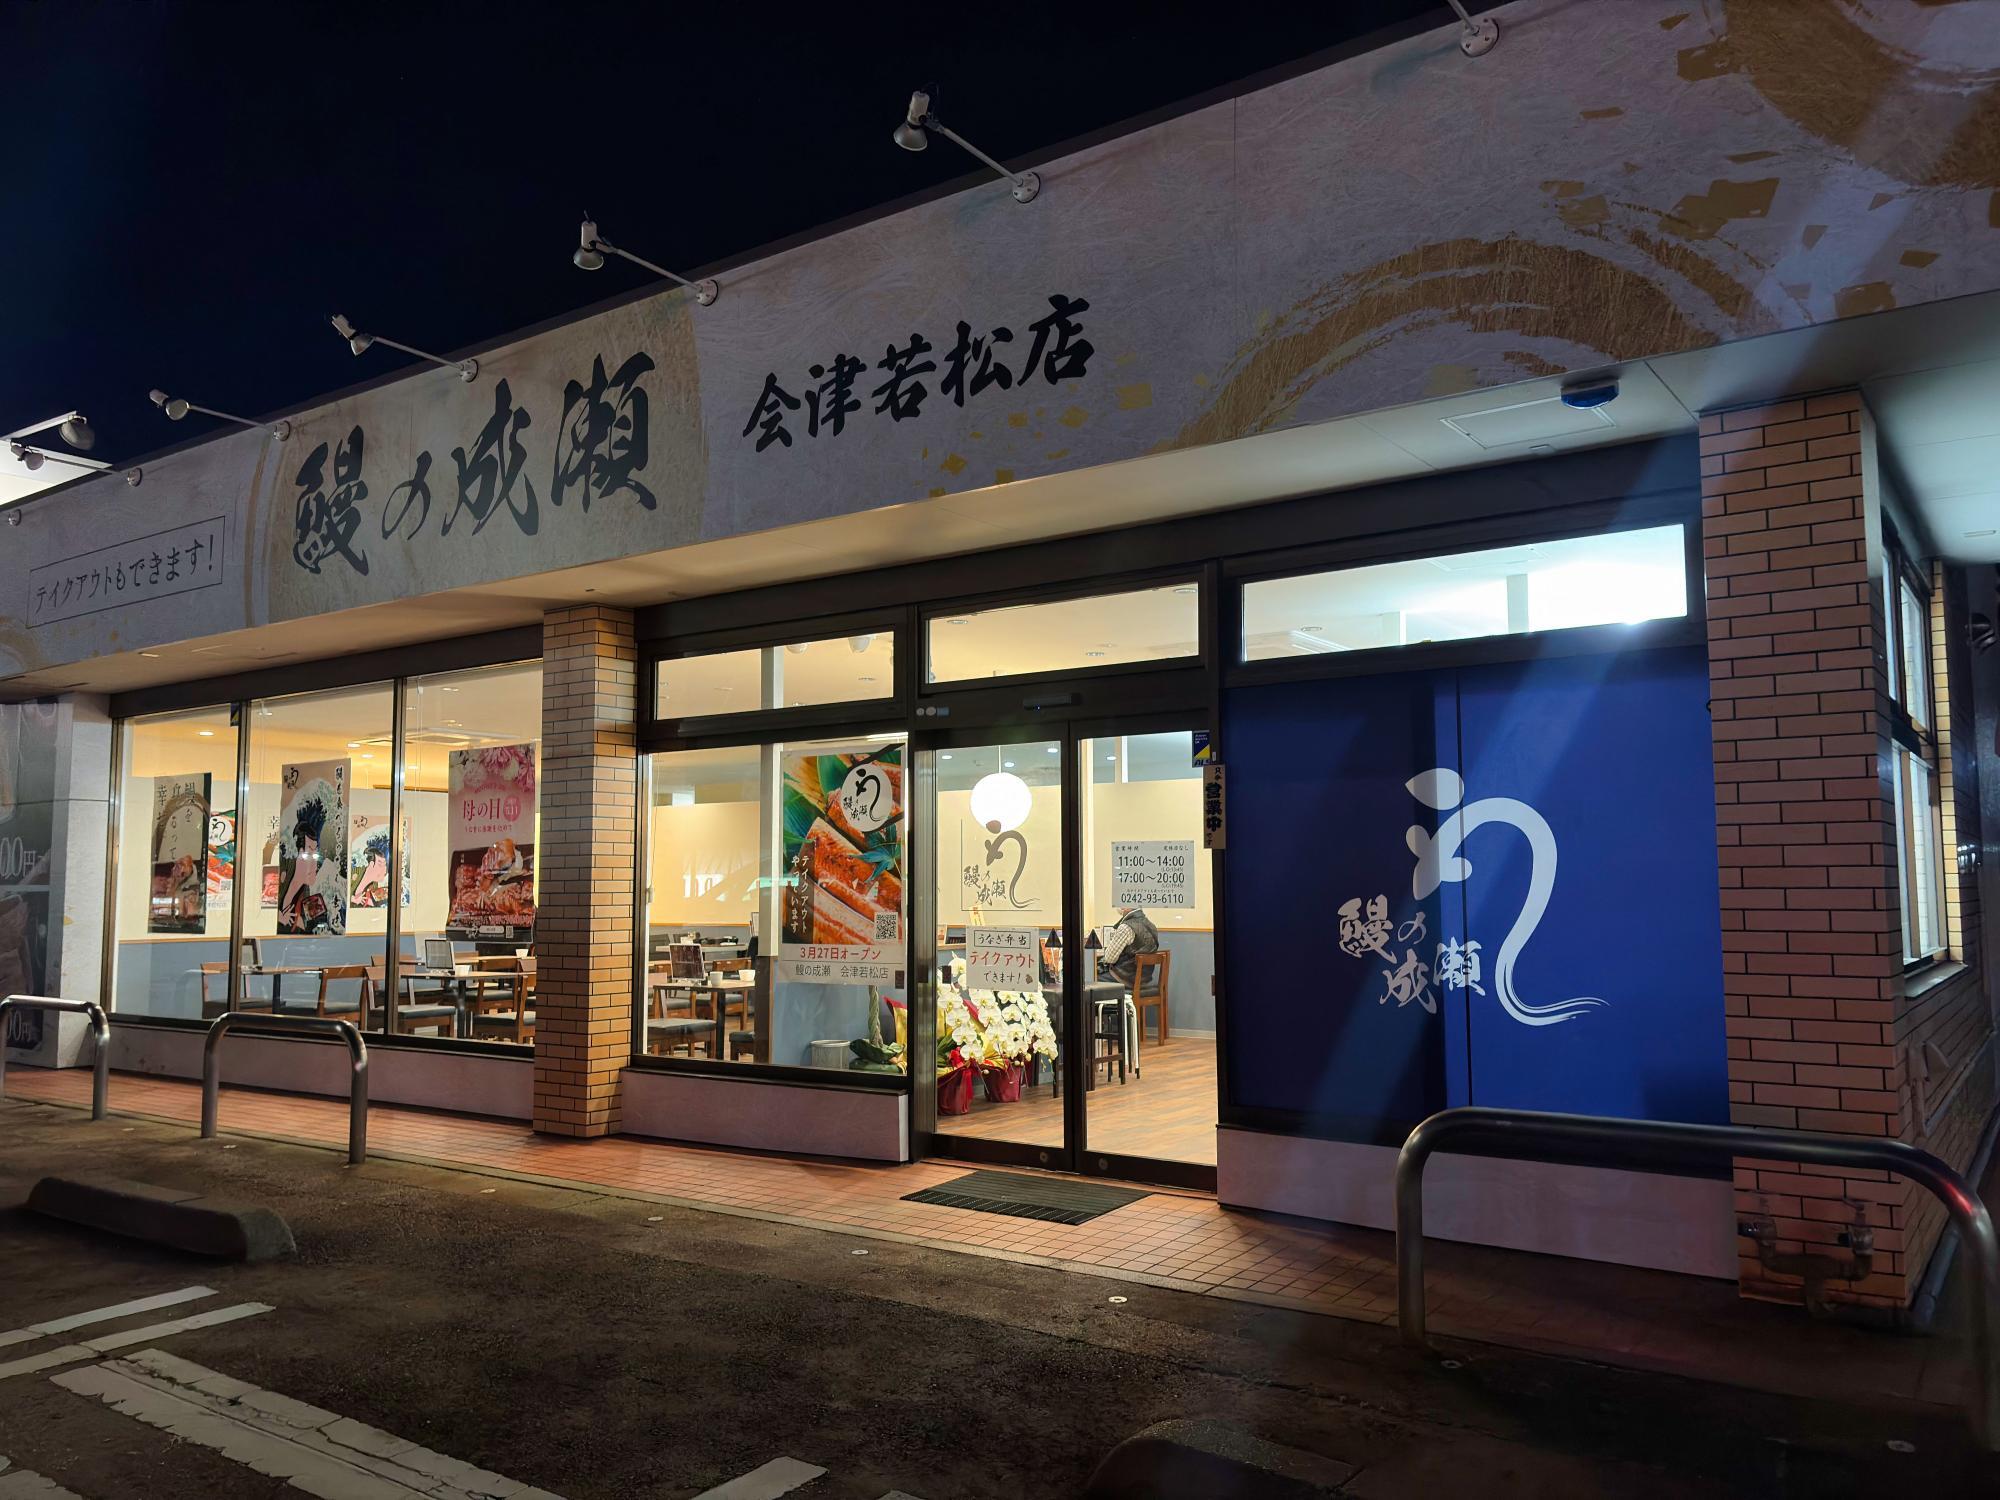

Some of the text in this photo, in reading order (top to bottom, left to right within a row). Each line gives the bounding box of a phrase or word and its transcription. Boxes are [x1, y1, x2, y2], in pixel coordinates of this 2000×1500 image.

[743, 294, 1095, 453] 会津若松店
[293, 351, 657, 577] 鰻の成瀬
[35, 534, 214, 615] テイクアウトもできます！
[463, 798, 500, 821] 母の日
[1205, 783, 1222, 832] 営業中
[791, 856, 799, 933] やっています
[1121, 894, 1184, 904] 0242-93-6110
[977, 934, 1027, 947] うなぎ弁当
[800, 947, 881, 960] 3月27日オープン
[970, 951, 1035, 969] テイクアウト
[1337, 894, 1486, 1014] 鰻の成瀬
[795, 964, 889, 979] 鰻の成瀬 会津若松店
[983, 971, 1021, 984] できます！
